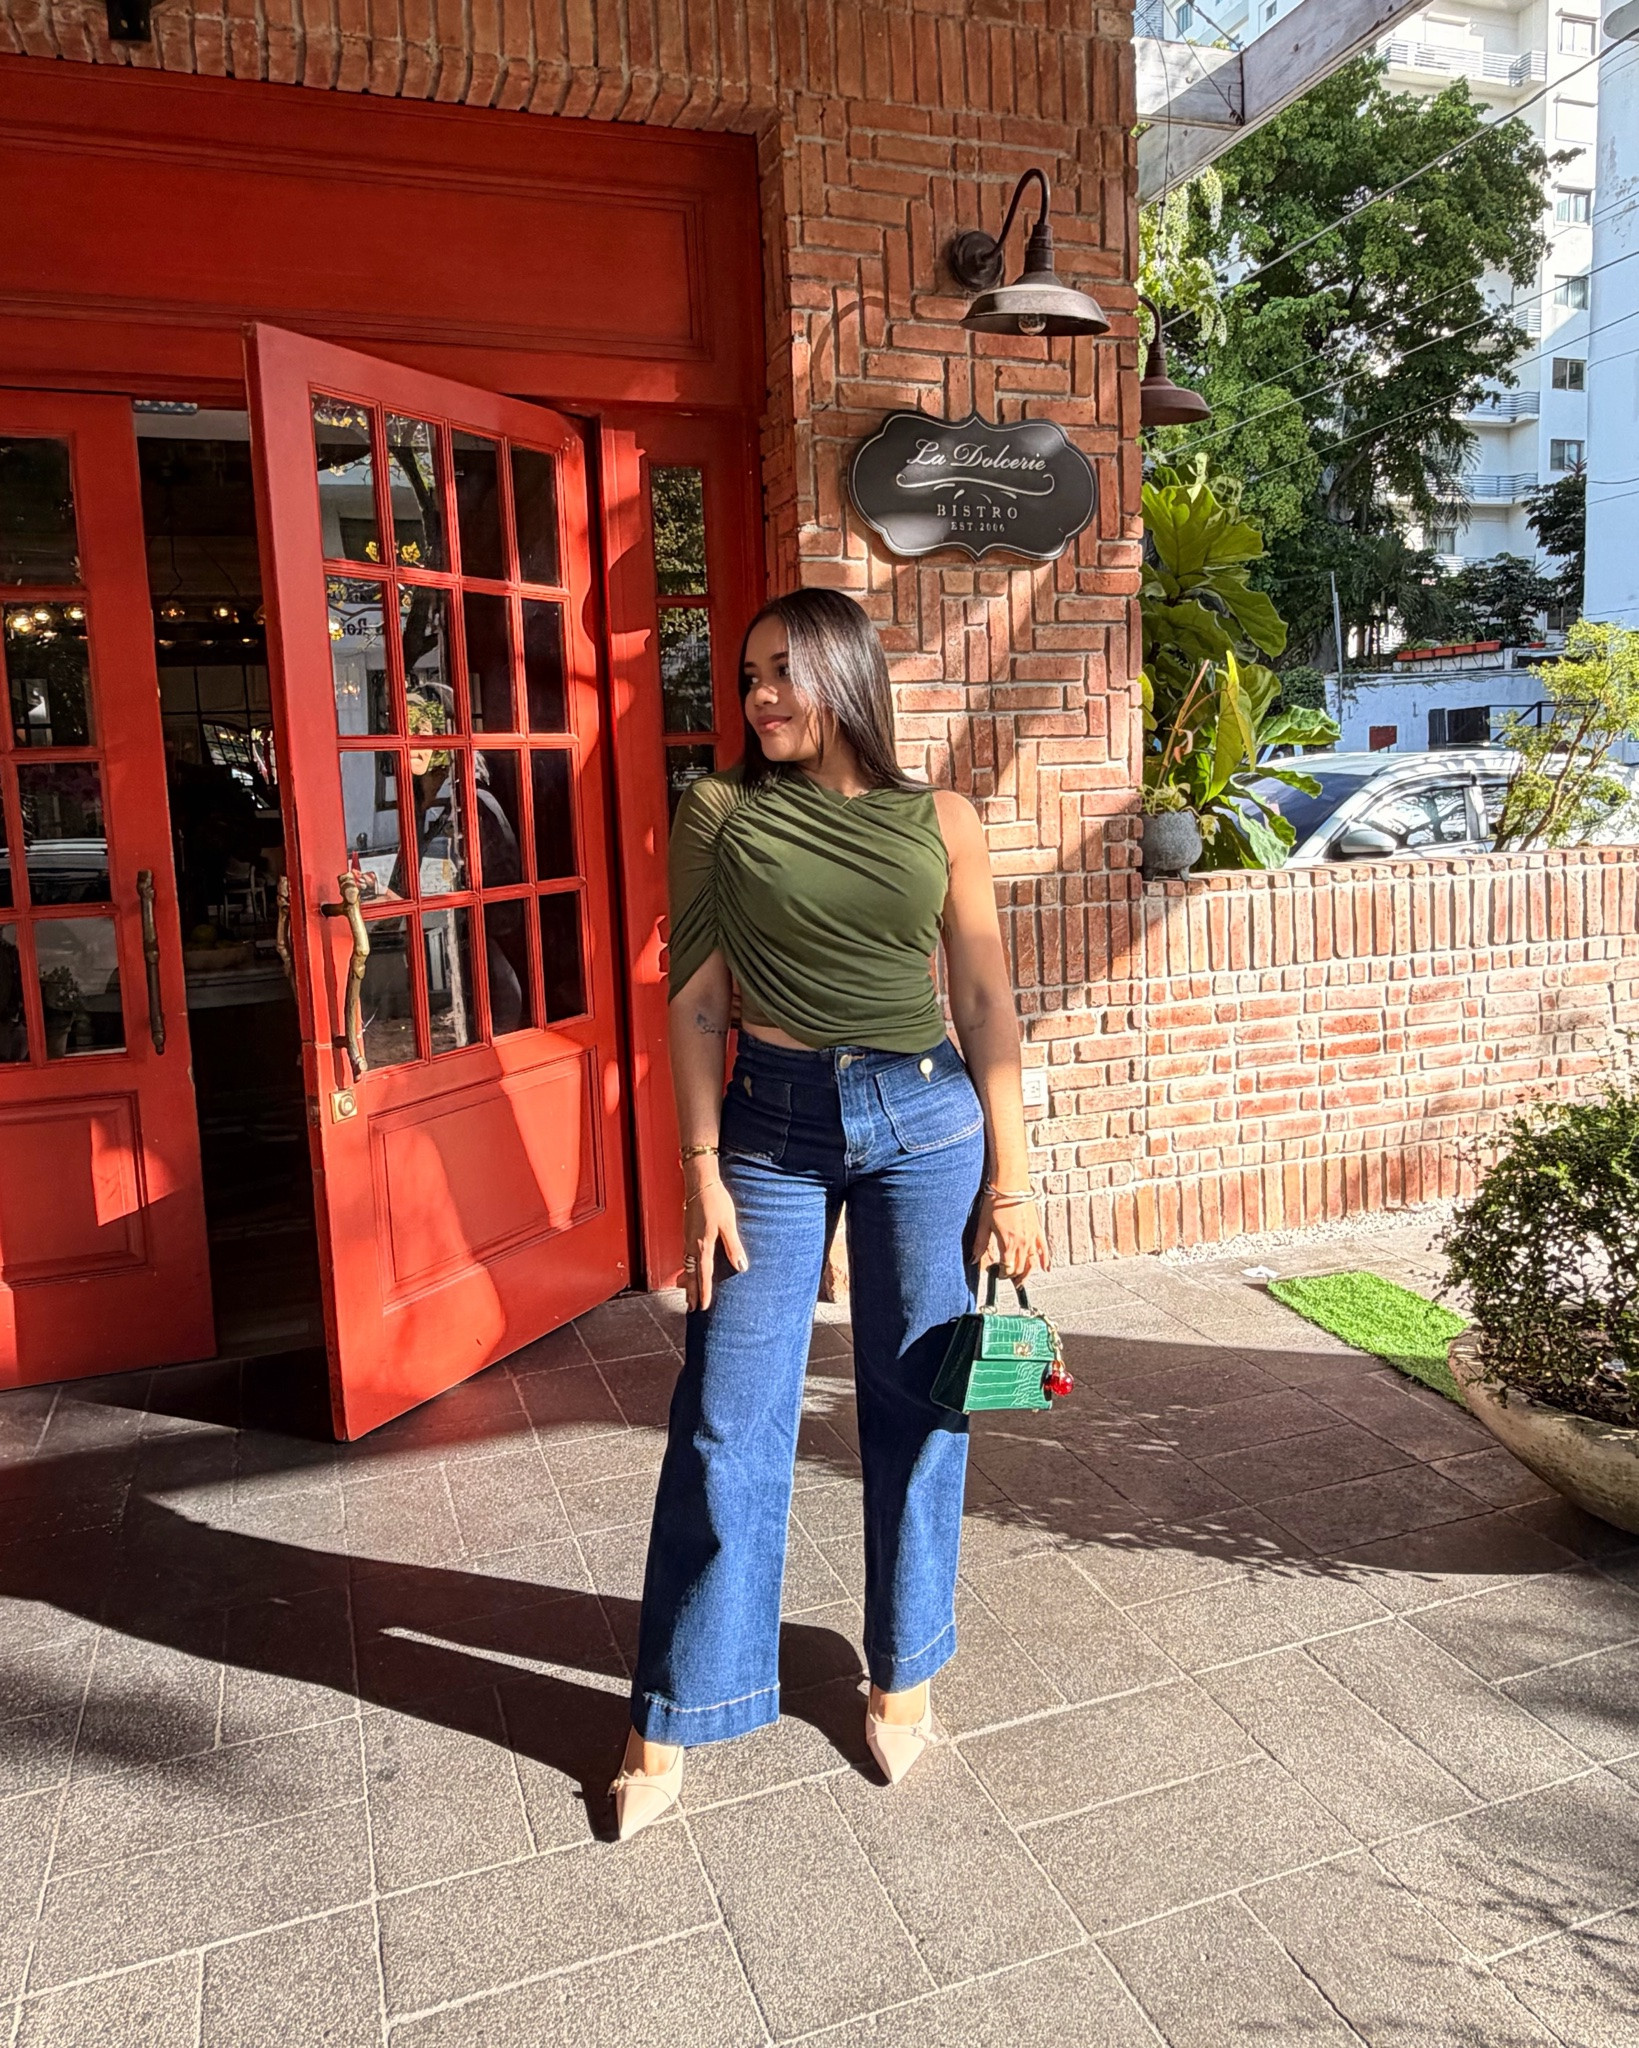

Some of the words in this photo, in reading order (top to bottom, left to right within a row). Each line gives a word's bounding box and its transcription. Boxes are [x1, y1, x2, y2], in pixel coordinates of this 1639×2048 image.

[906, 438, 947, 466] La
[950, 442, 1047, 470] Dolcerie
[936, 503, 1018, 520] BISTRO
